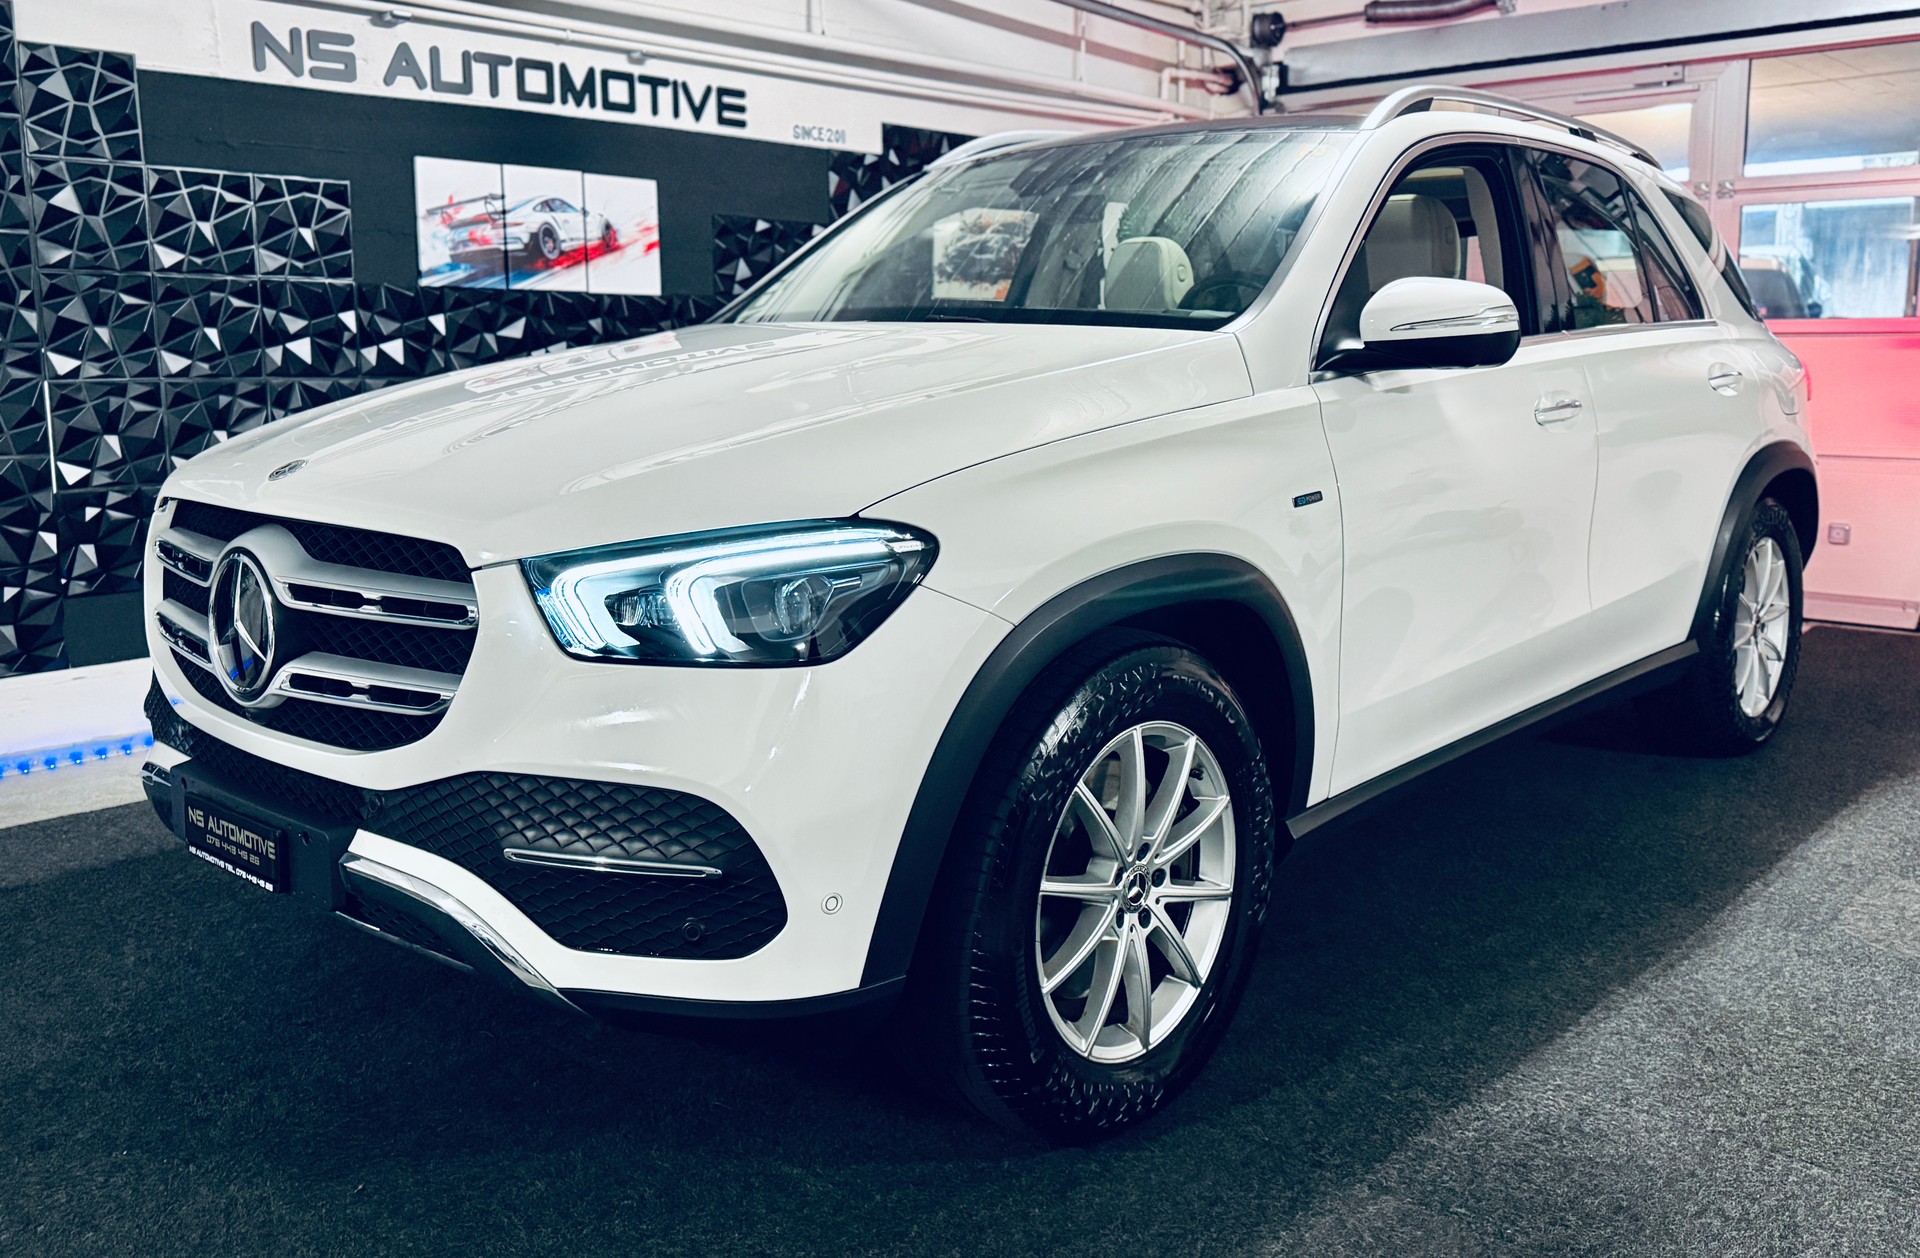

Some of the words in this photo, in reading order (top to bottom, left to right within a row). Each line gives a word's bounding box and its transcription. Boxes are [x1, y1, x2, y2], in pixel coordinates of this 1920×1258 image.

[251, 20, 357, 82] NS
[383, 41, 748, 128] AUTOMOTIVE
[792, 124, 825, 142] SINCE
[188, 806, 204, 828] NS
[208, 815, 276, 859] AUTOMOTIVE
